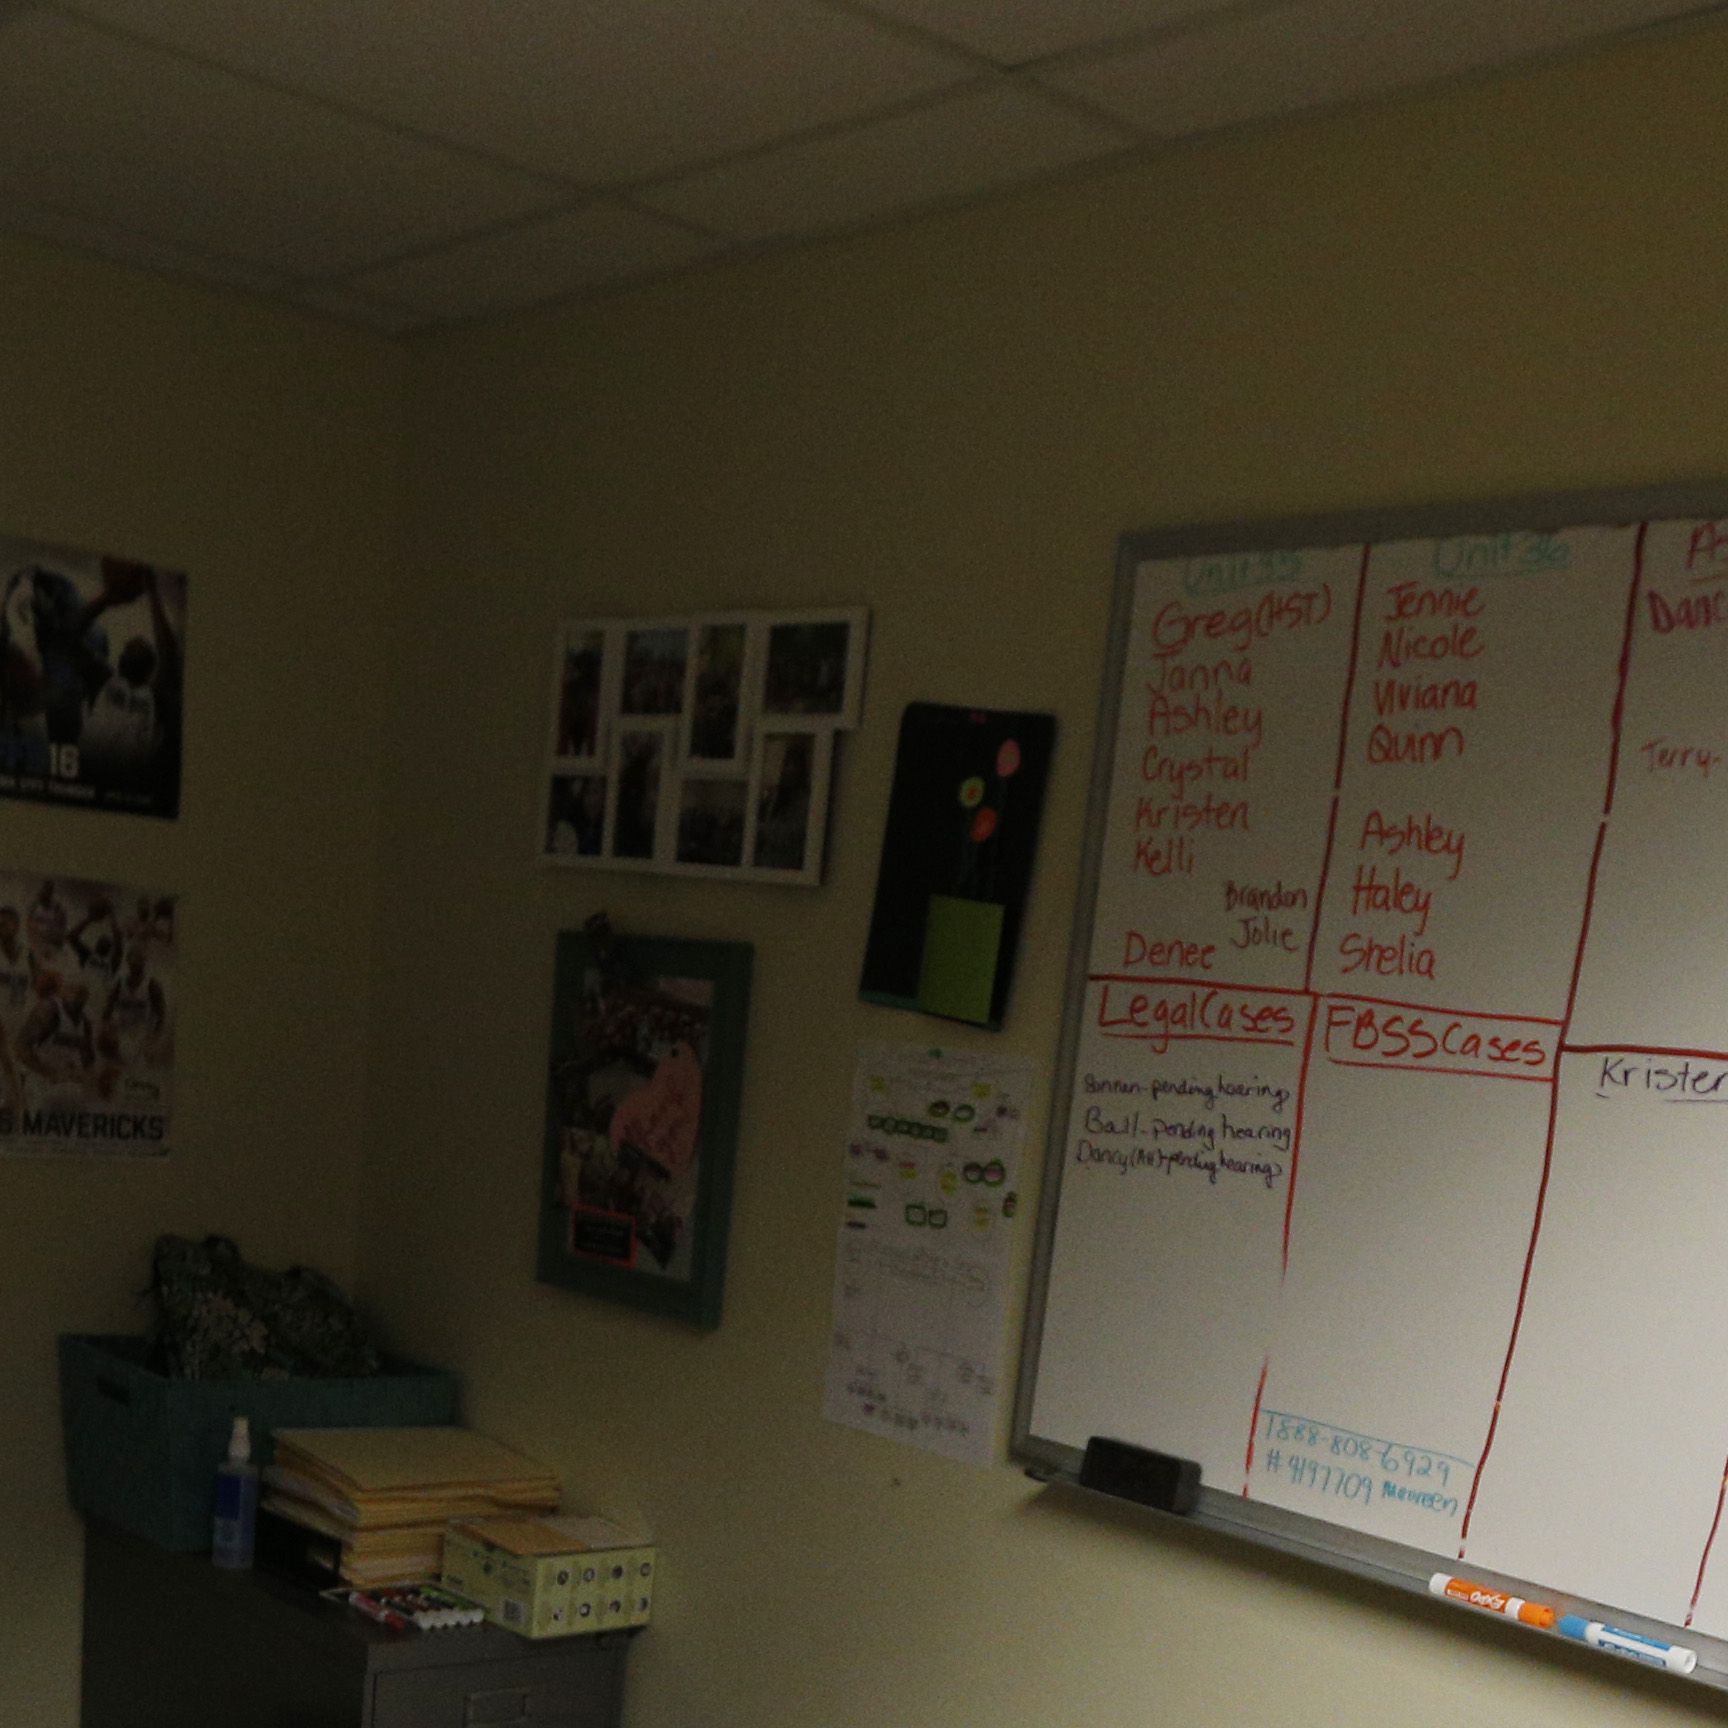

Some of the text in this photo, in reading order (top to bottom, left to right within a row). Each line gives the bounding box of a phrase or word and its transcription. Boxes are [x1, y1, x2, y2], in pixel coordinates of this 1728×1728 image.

[1377, 624, 1486, 668] Nicole
[1146, 653, 1253, 695] Janna
[1148, 690, 1263, 751] Ashley
[1140, 743, 1249, 801] Crystal
[1134, 792, 1250, 832] Kristen
[1134, 836, 1194, 876] Kelli
[1360, 809, 1465, 882] Ashley
[1352, 863, 1432, 937] Haley
[1098, 983, 1295, 1055] Legal Cases
[1440, 1020, 1546, 1066] Cases
[23, 1108, 166, 1142] MAVERICKS
[1221, 1112, 1292, 1152] hearing
